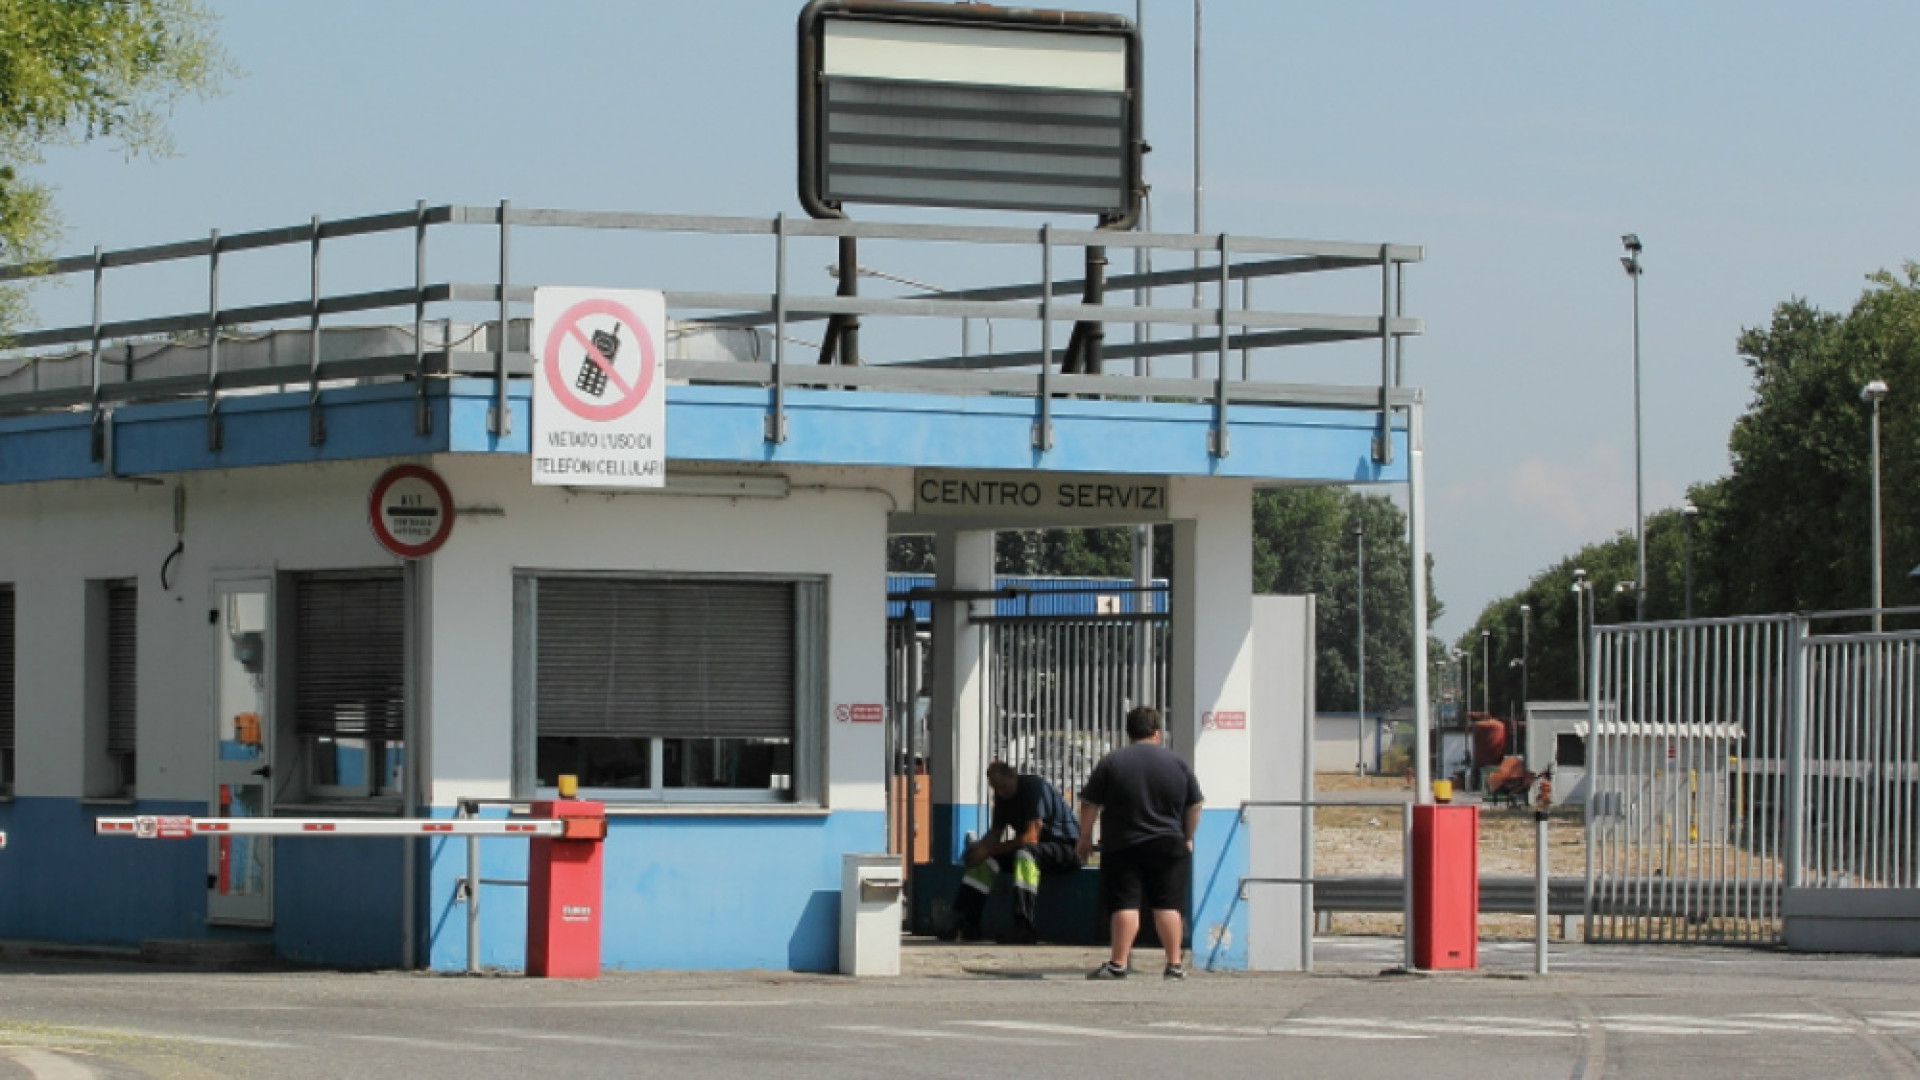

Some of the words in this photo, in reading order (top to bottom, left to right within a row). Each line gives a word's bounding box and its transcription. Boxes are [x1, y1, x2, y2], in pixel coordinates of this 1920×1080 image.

[549, 431, 597, 447] VIETATO
[601, 433, 635, 449] L'USO
[639, 433, 651, 449] DI
[536, 458, 596, 474] TELEFONI
[597, 460, 663, 476] CELLULARI
[920, 479, 1042, 507] CENTRO
[1058, 483, 1164, 510] SERVIZI
